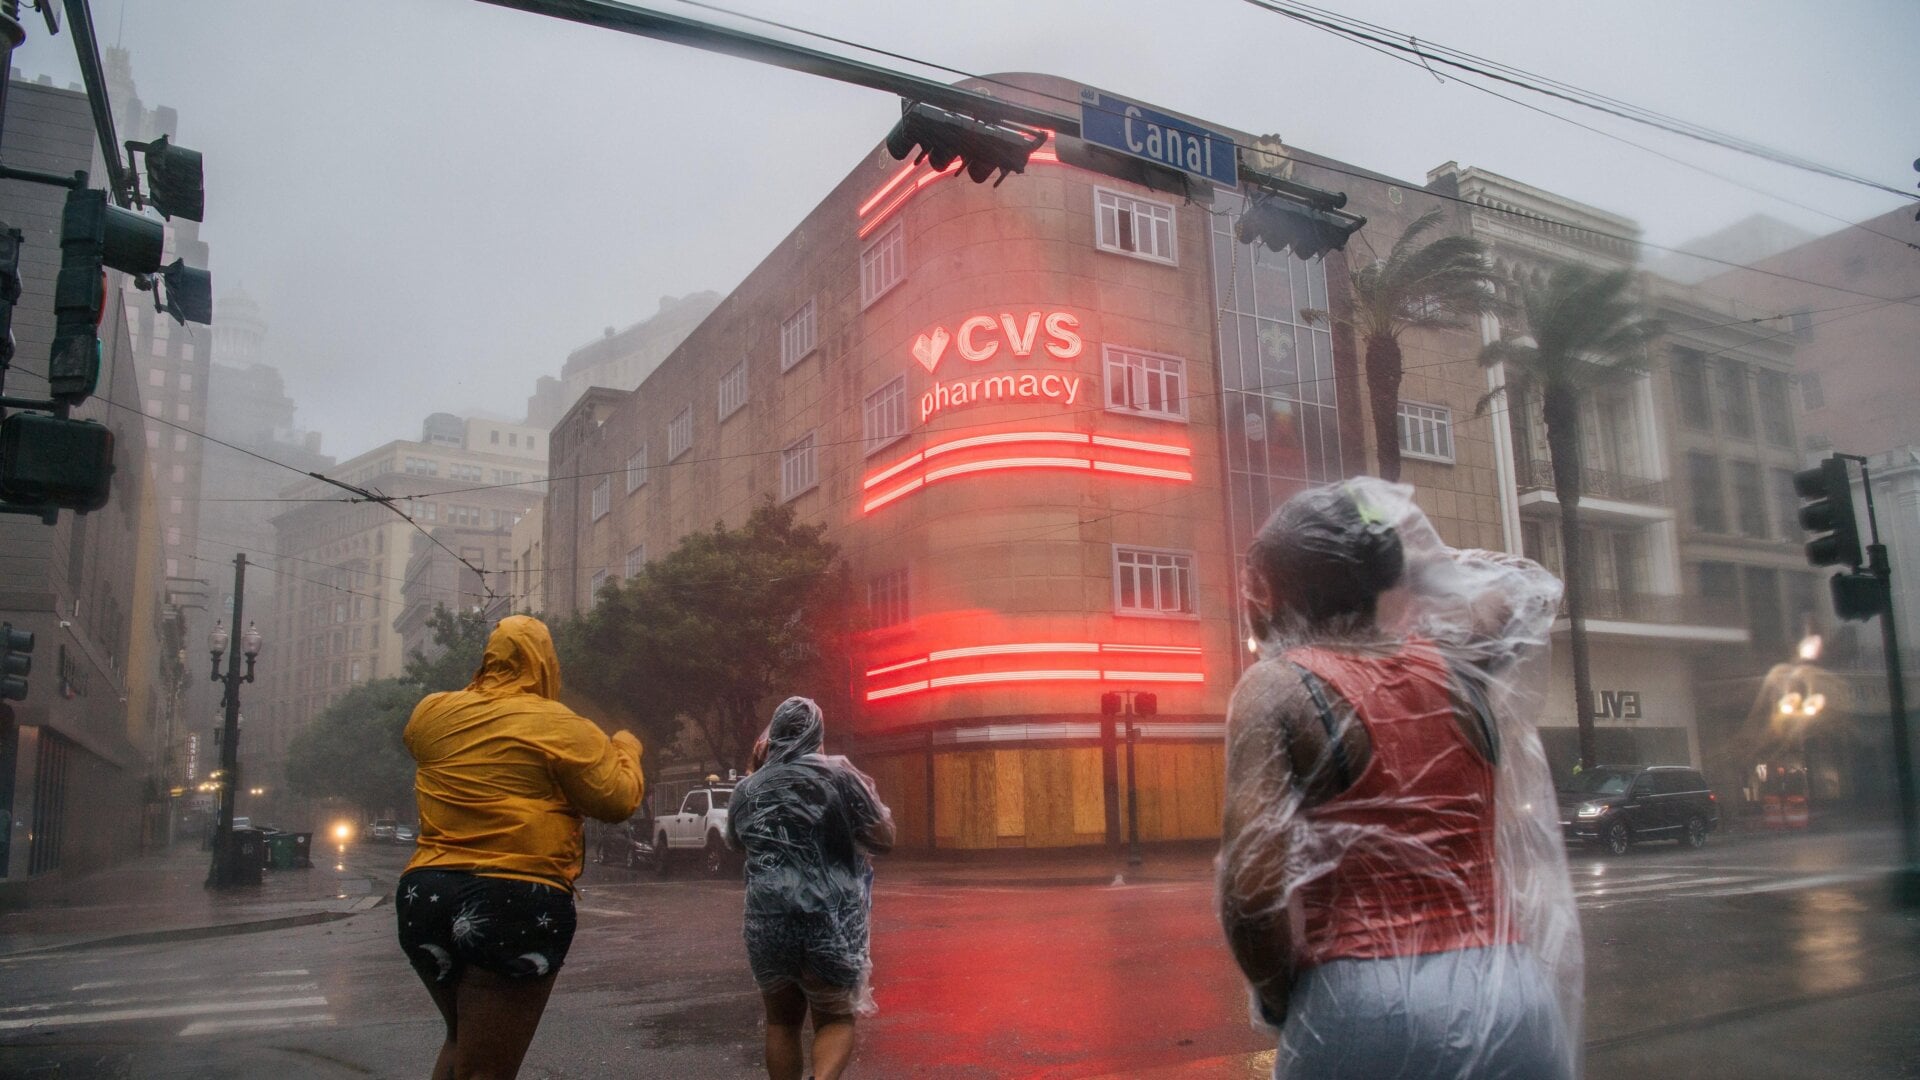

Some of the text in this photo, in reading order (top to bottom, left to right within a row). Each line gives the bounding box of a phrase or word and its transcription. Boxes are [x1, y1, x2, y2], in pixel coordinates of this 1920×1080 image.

[1124, 106, 1212, 177] Canal
[957, 311, 1082, 362] CVS
[921, 374, 1080, 422] pharmacy
